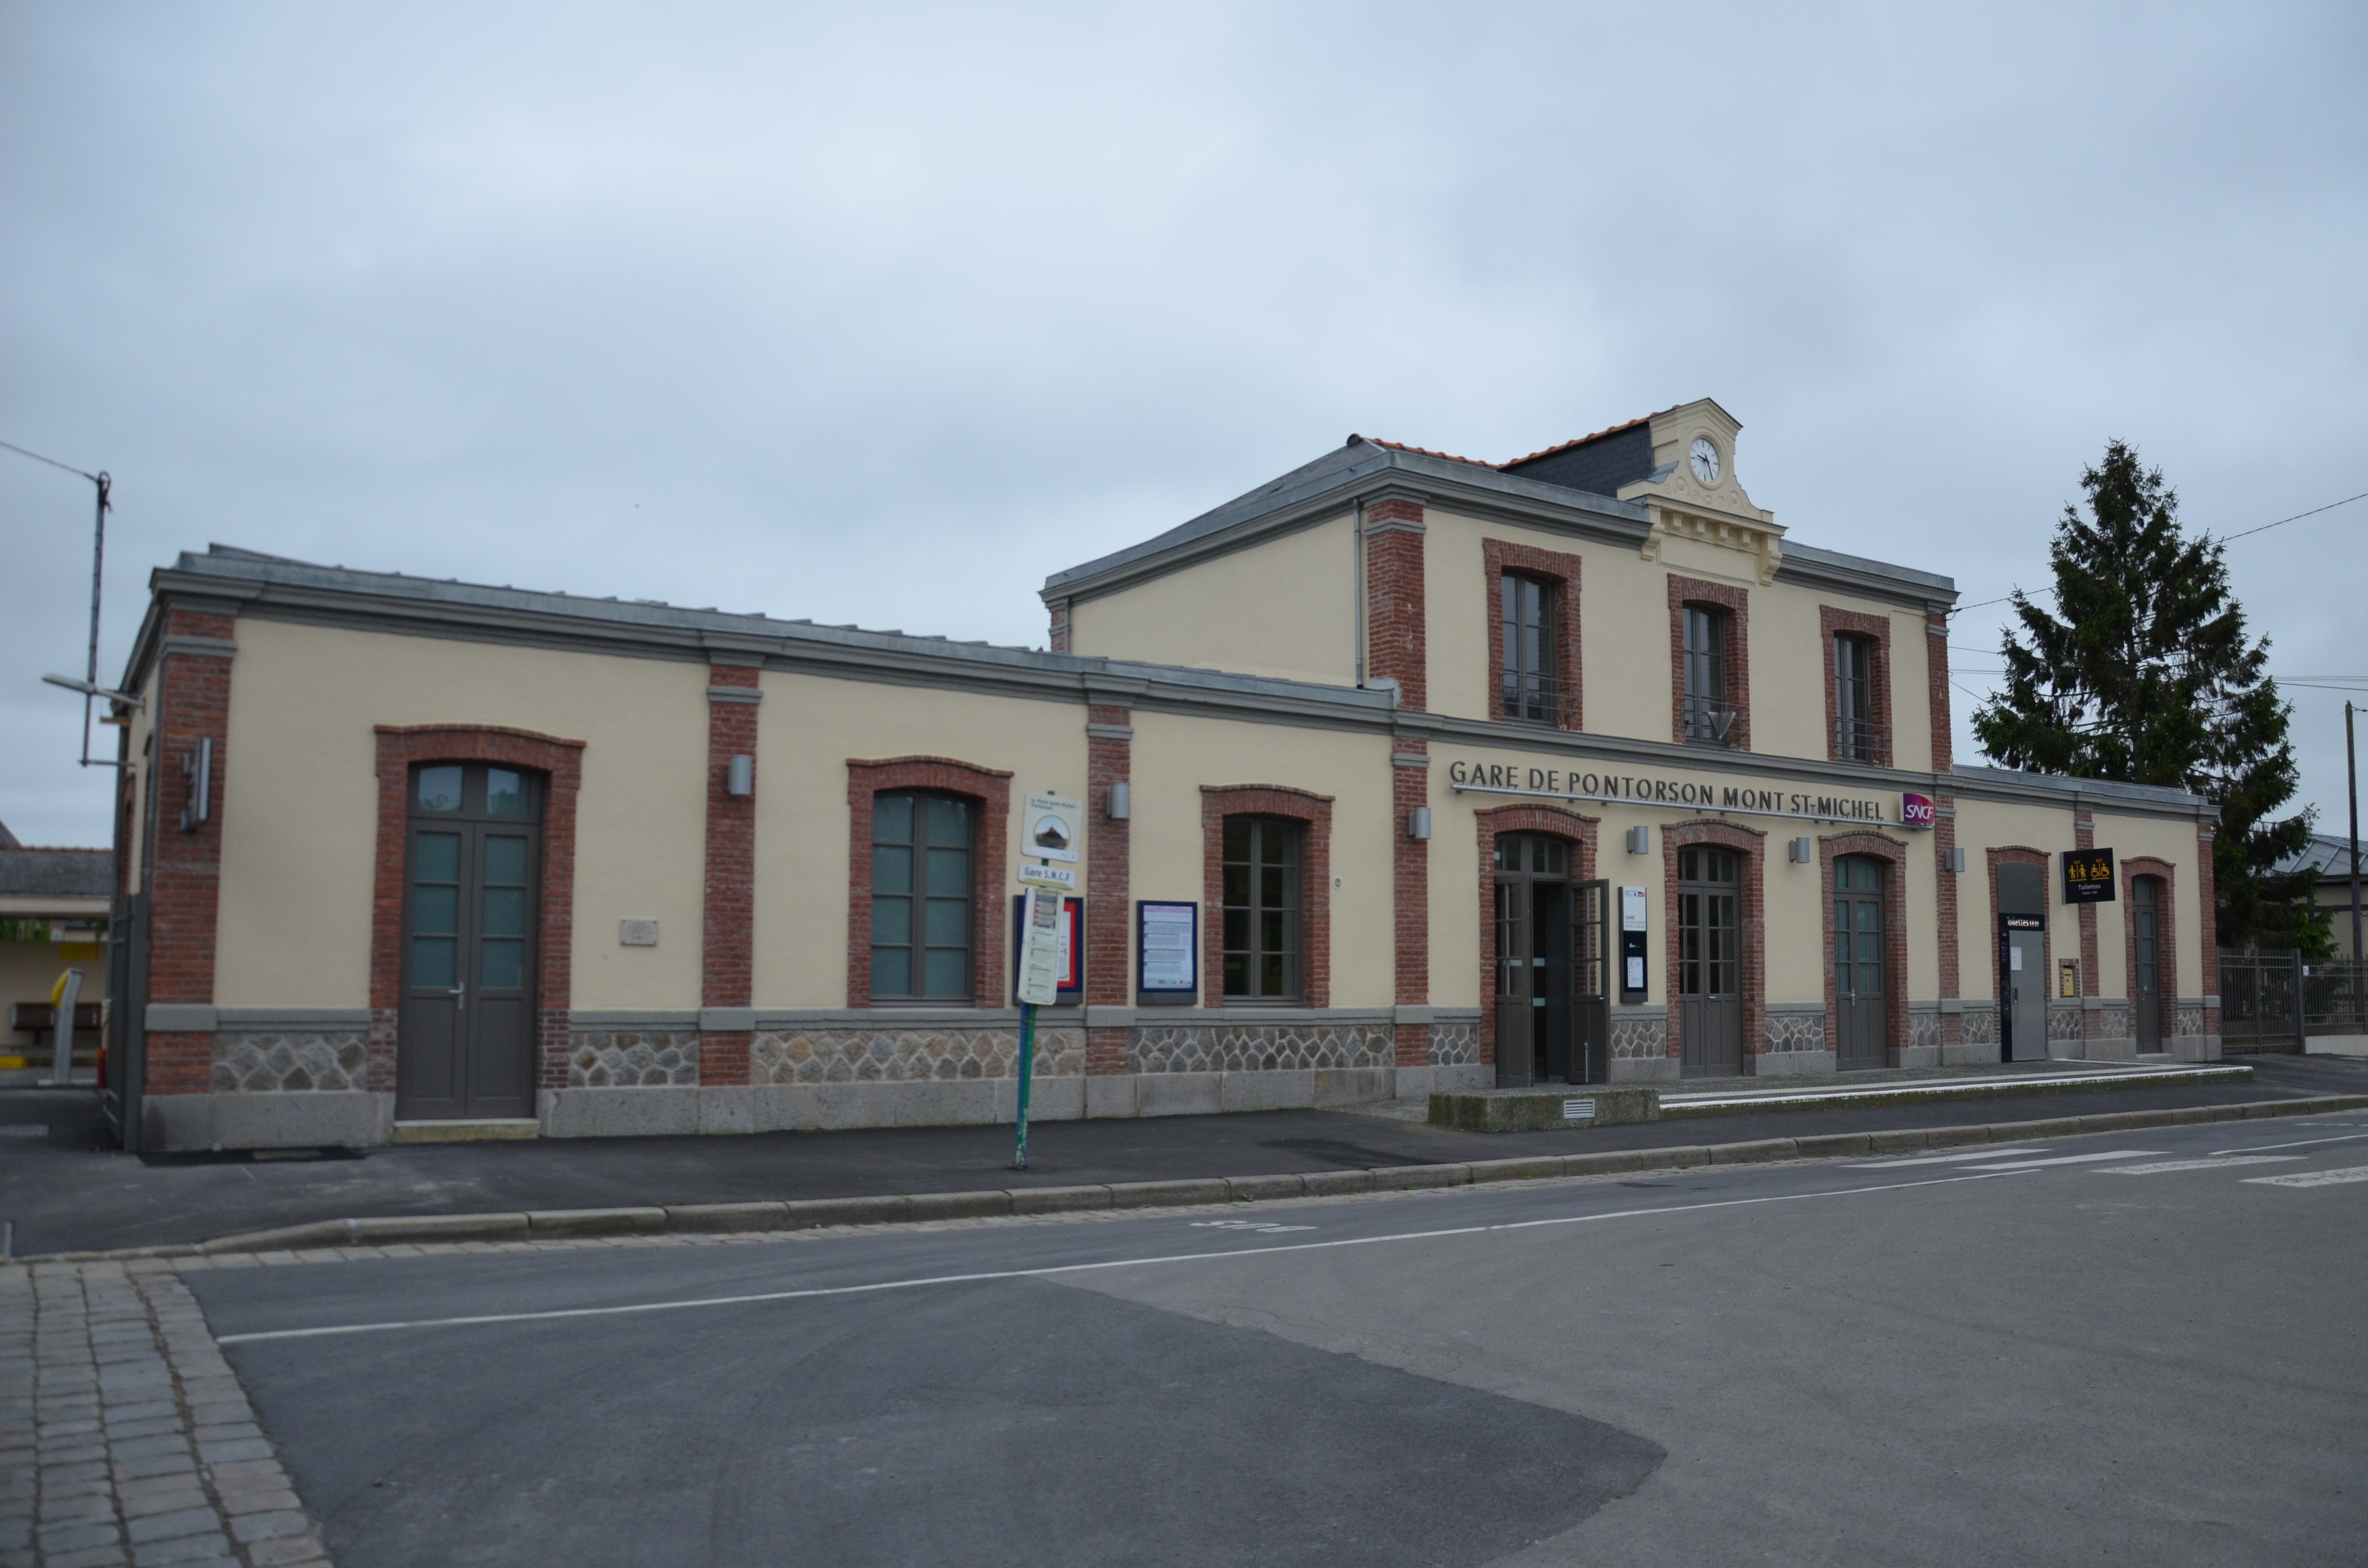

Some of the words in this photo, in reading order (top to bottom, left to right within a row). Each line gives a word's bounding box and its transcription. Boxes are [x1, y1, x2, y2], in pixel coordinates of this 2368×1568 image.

[1449, 760, 1518, 787] GARE
[1529, 768, 1560, 791] DE
[1569, 772, 1713, 805] PONTORSON
[1723, 787, 1785, 811] MONT
[1905, 804, 1934, 820] SNCF
[1024, 866, 1042, 877] Gare
[2006, 917, 2029, 927] Toilettes
[1189, 1220, 1319, 1233] BUS
